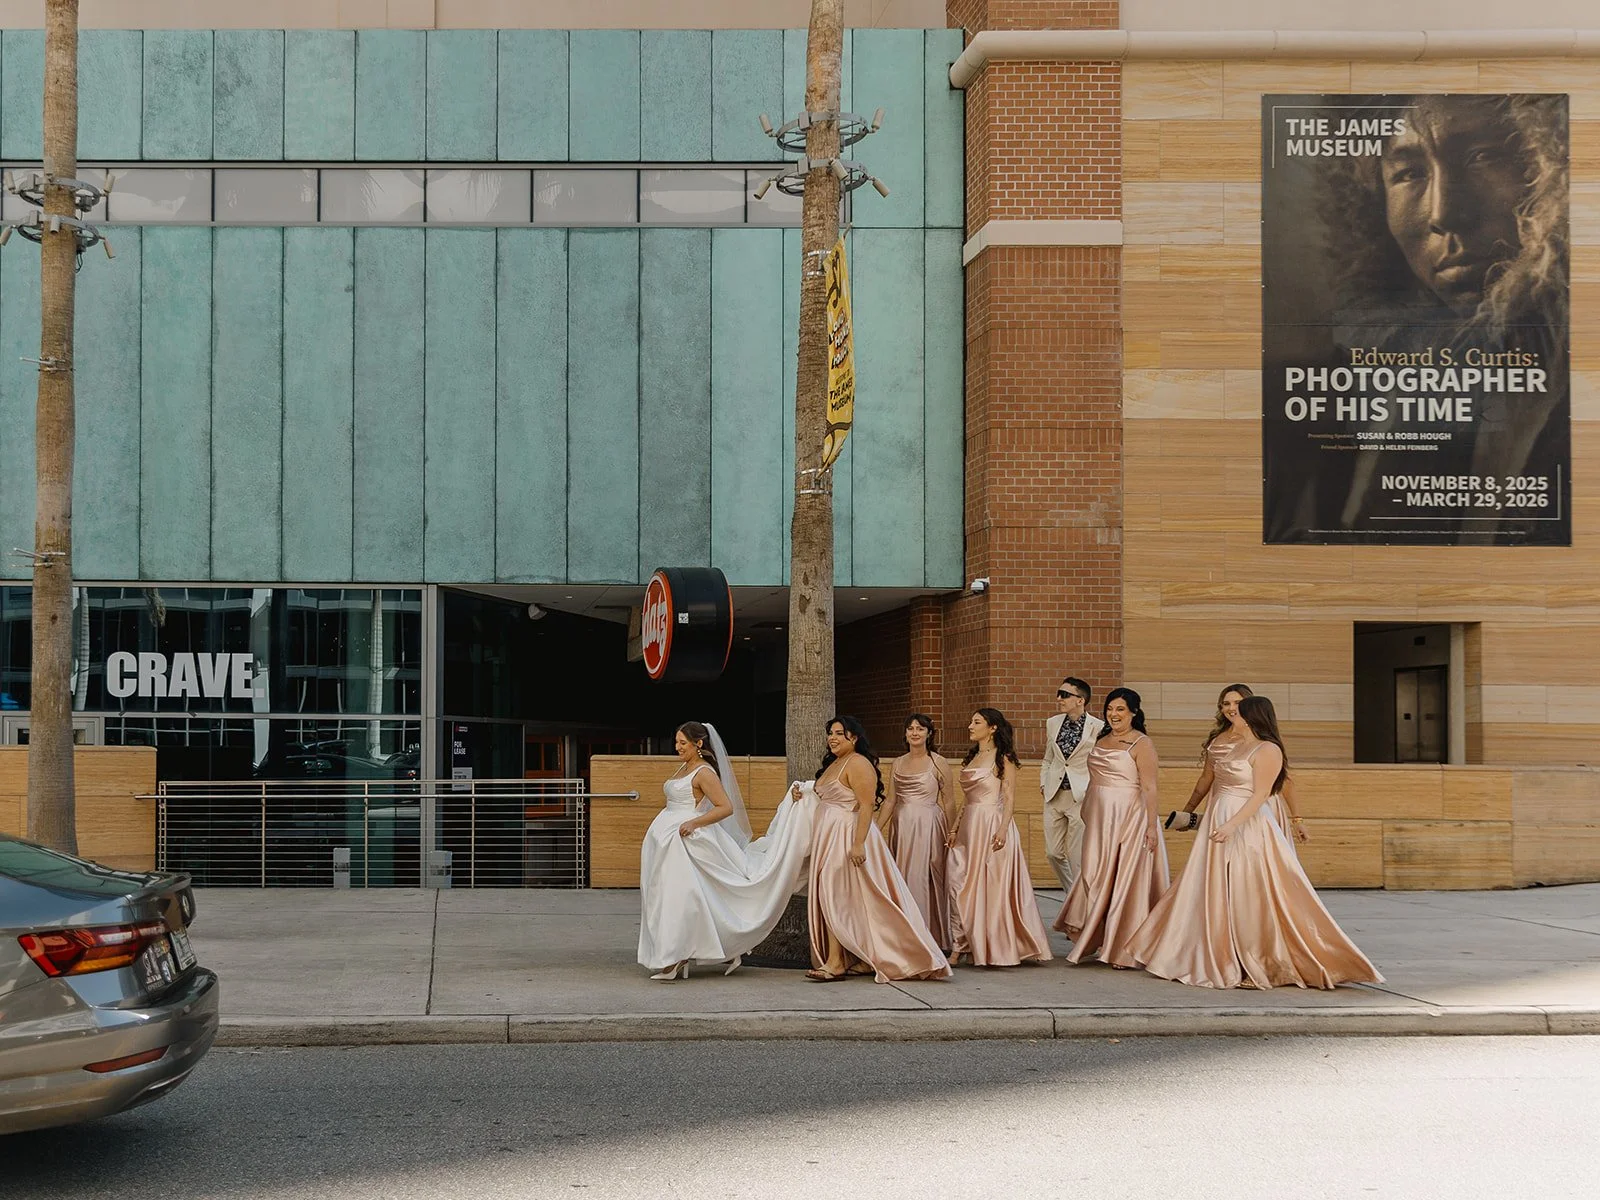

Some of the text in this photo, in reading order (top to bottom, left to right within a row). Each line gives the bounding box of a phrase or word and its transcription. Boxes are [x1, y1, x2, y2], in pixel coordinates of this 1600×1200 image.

[1286, 118, 1406, 136] THE JAMES
[1286, 138, 1382, 157] MUSEUM
[1350, 347, 1539, 367] Edward S. Curtis:
[1285, 367, 1548, 393] PHOTOGRAPHER
[1284, 396, 1473, 422] OF HIS TIME
[1356, 431, 1386, 441] SUSAN
[1386, 432, 1394, 441] &
[1394, 432, 1419, 441] ROBB
[1420, 432, 1452, 441] HOUGH
[1381, 475, 1548, 493] NOVEMBER 8, 2025
[1406, 492, 1470, 507] MARCH
[1473, 492, 1502, 510] 29,
[1505, 492, 1549, 507] 2026
